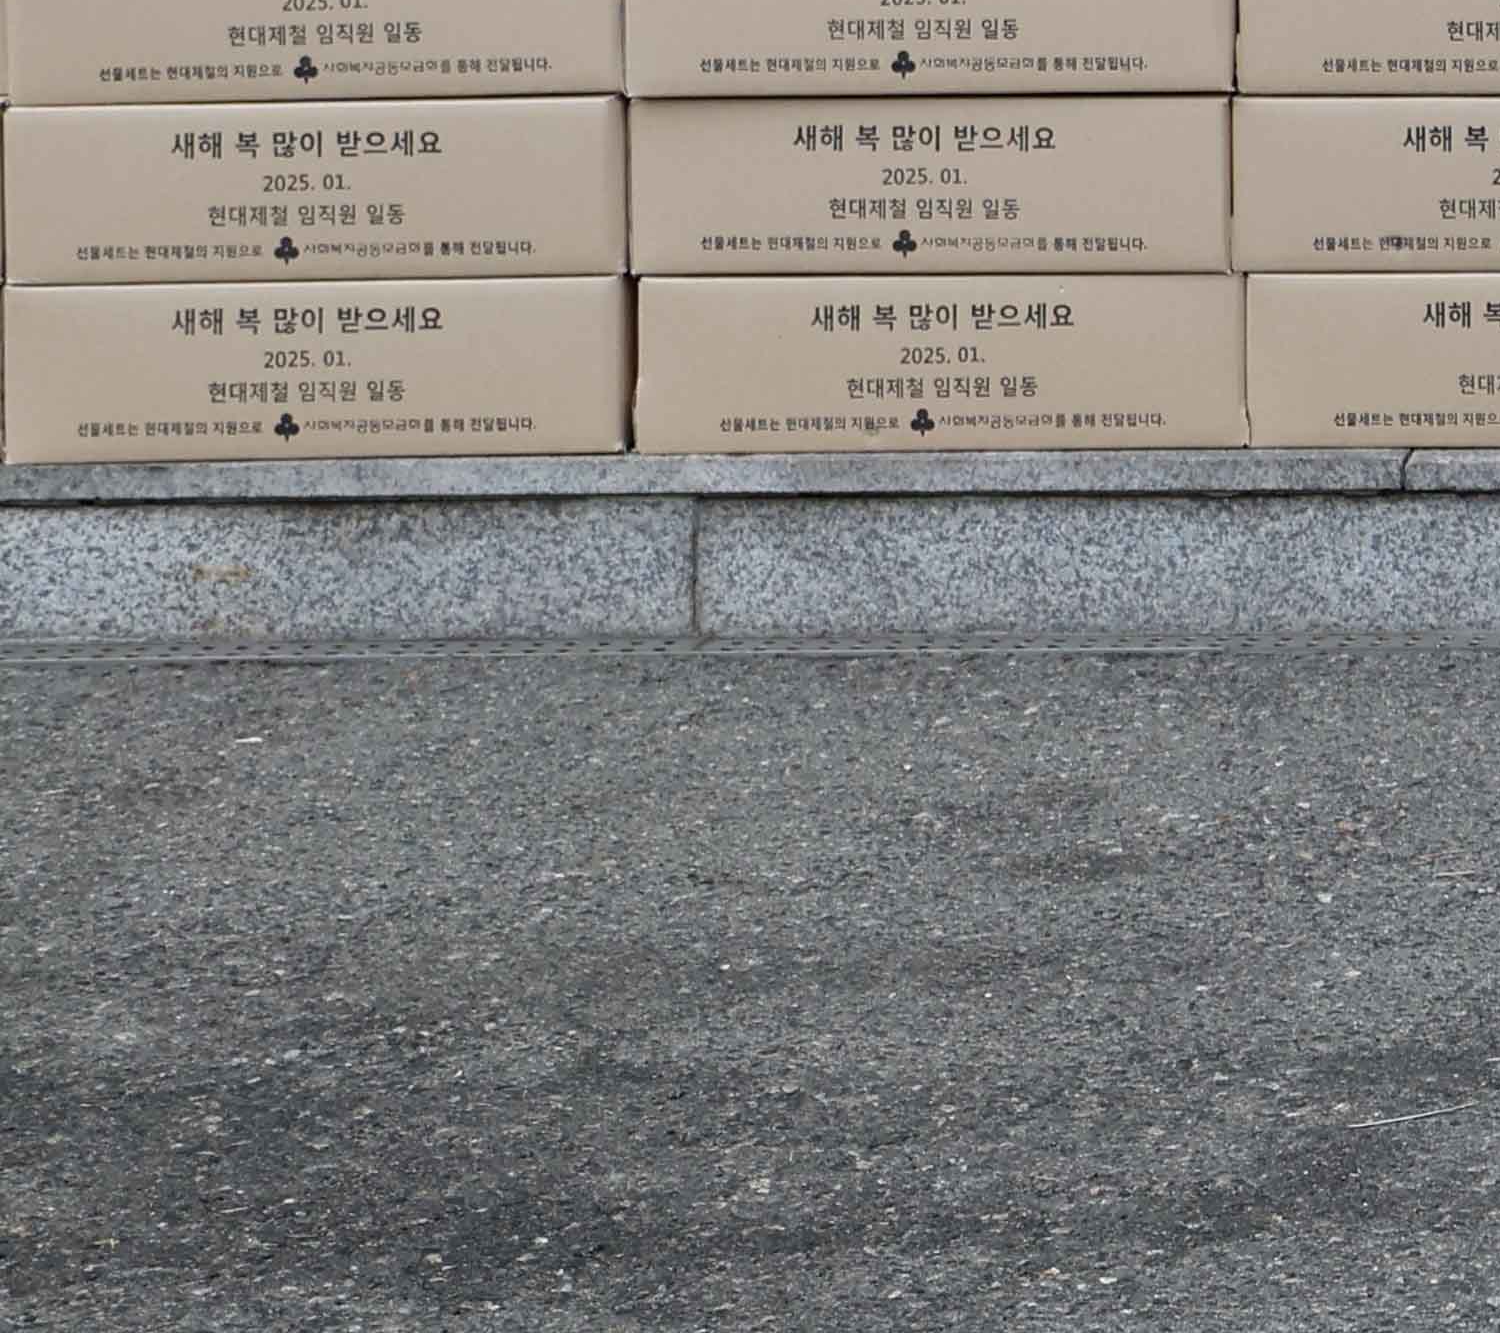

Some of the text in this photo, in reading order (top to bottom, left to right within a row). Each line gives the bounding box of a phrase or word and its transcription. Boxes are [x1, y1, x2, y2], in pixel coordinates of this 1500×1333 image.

[1423, 301, 1471, 329] 새해
[1334, 413, 1394, 429] 선물세트는
[1399, 413, 1458, 428] 현대제철의
